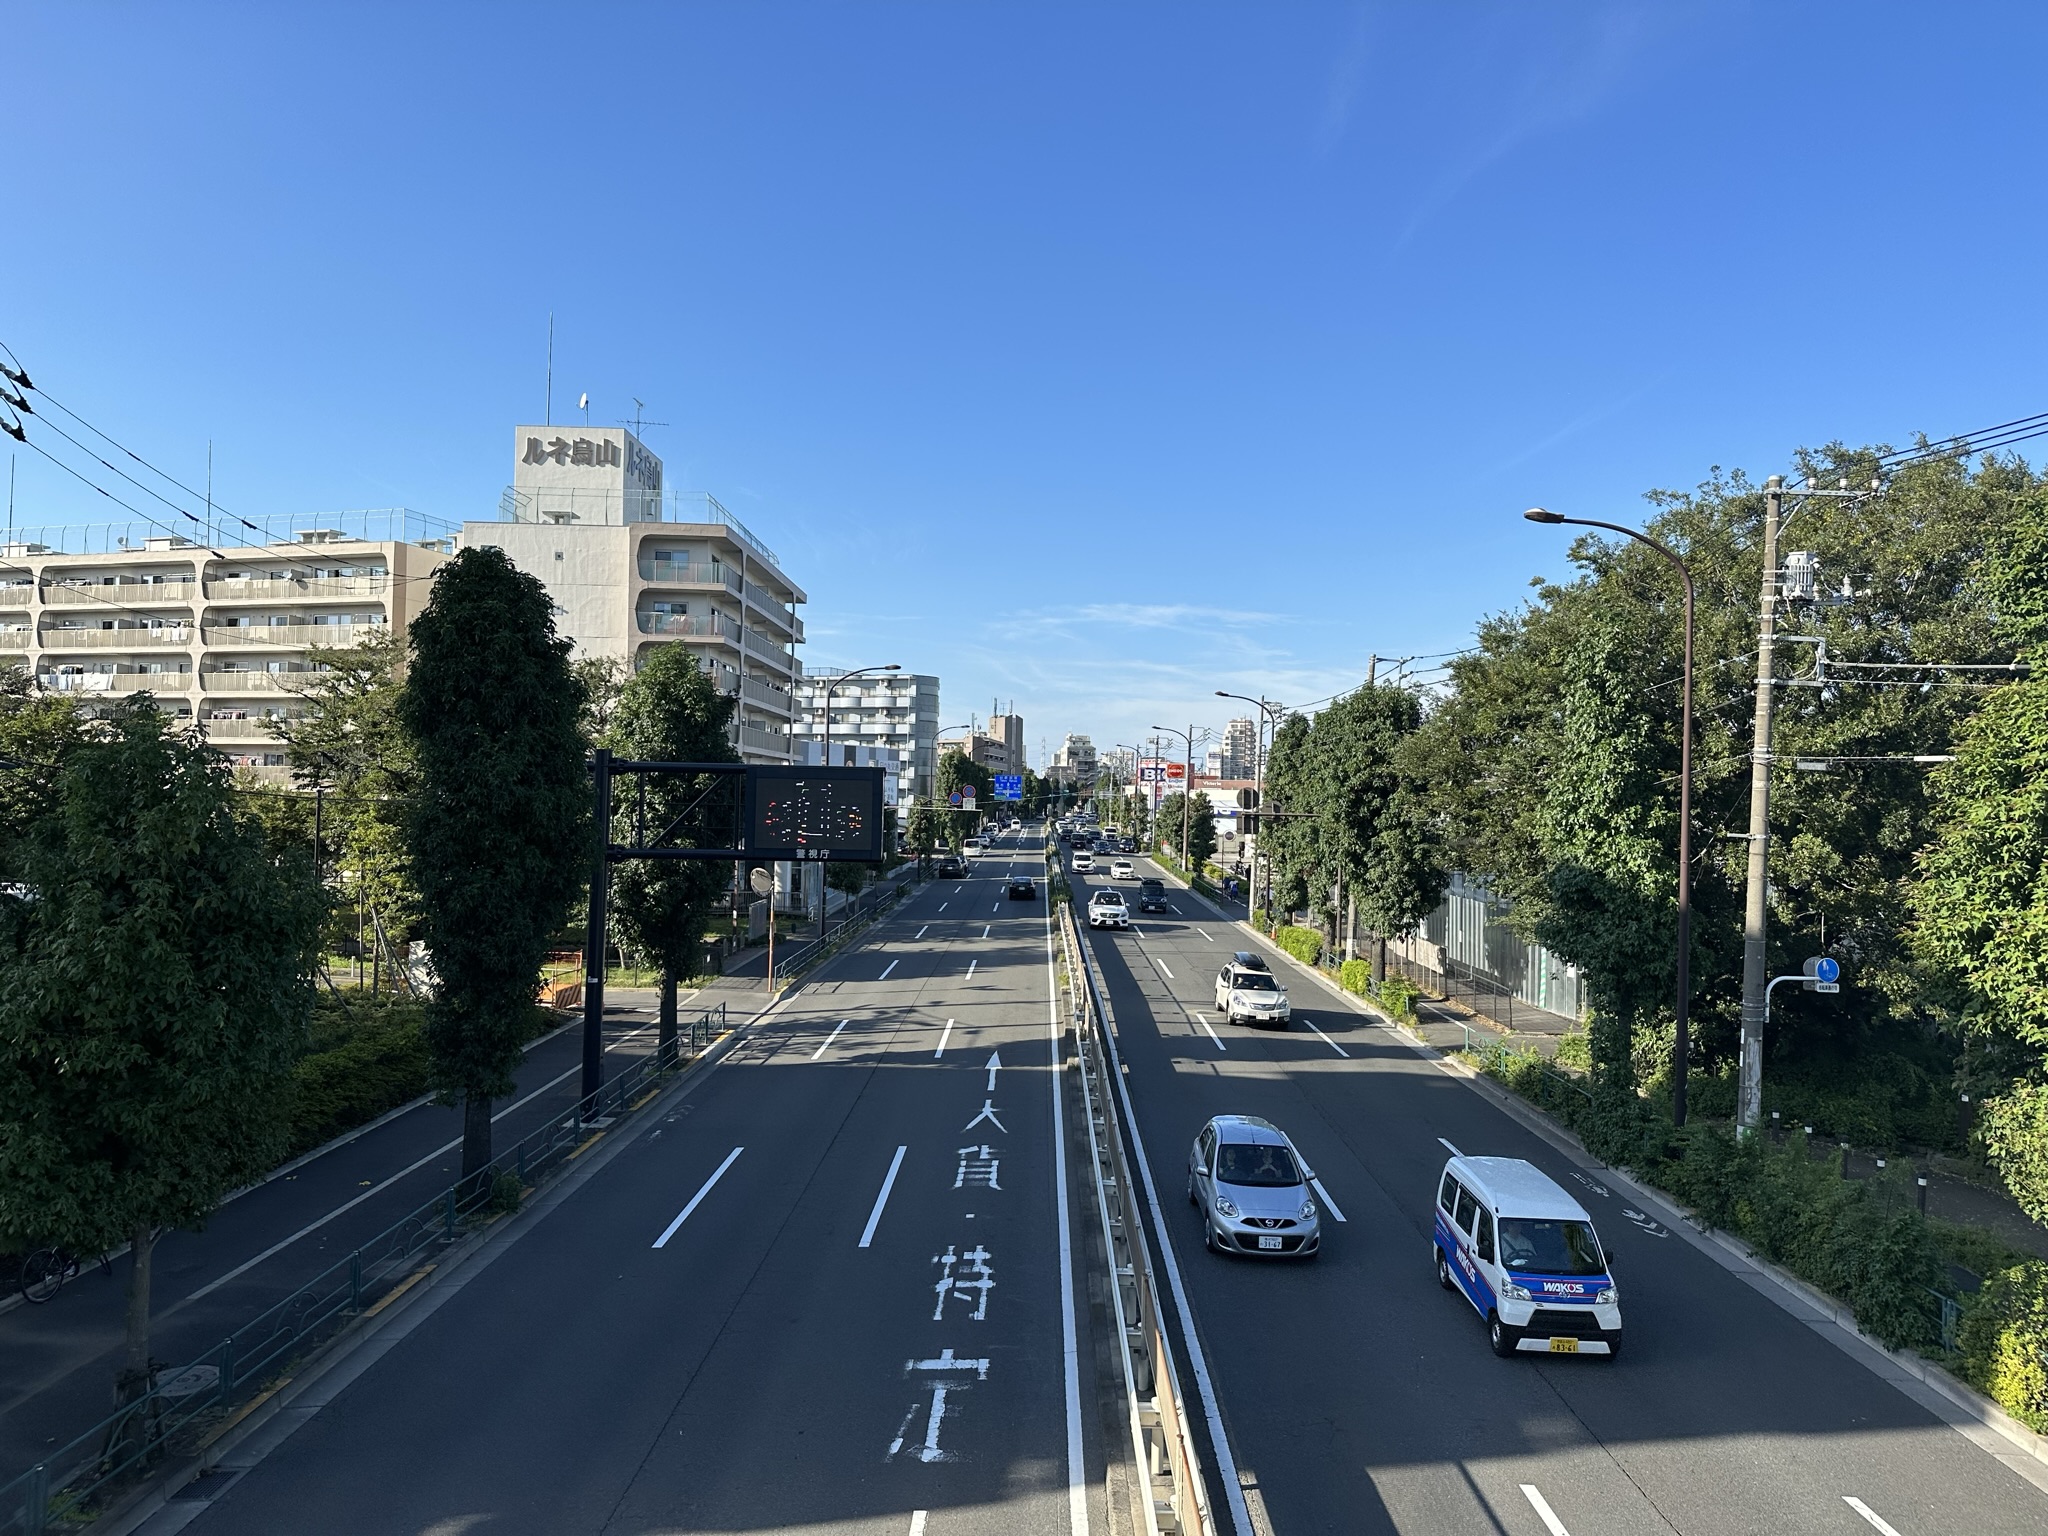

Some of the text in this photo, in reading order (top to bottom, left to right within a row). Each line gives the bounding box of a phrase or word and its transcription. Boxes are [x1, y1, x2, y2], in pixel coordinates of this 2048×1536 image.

[521, 436, 620, 467] ルネ烏山
[796, 849, 830, 859] 警視庁
